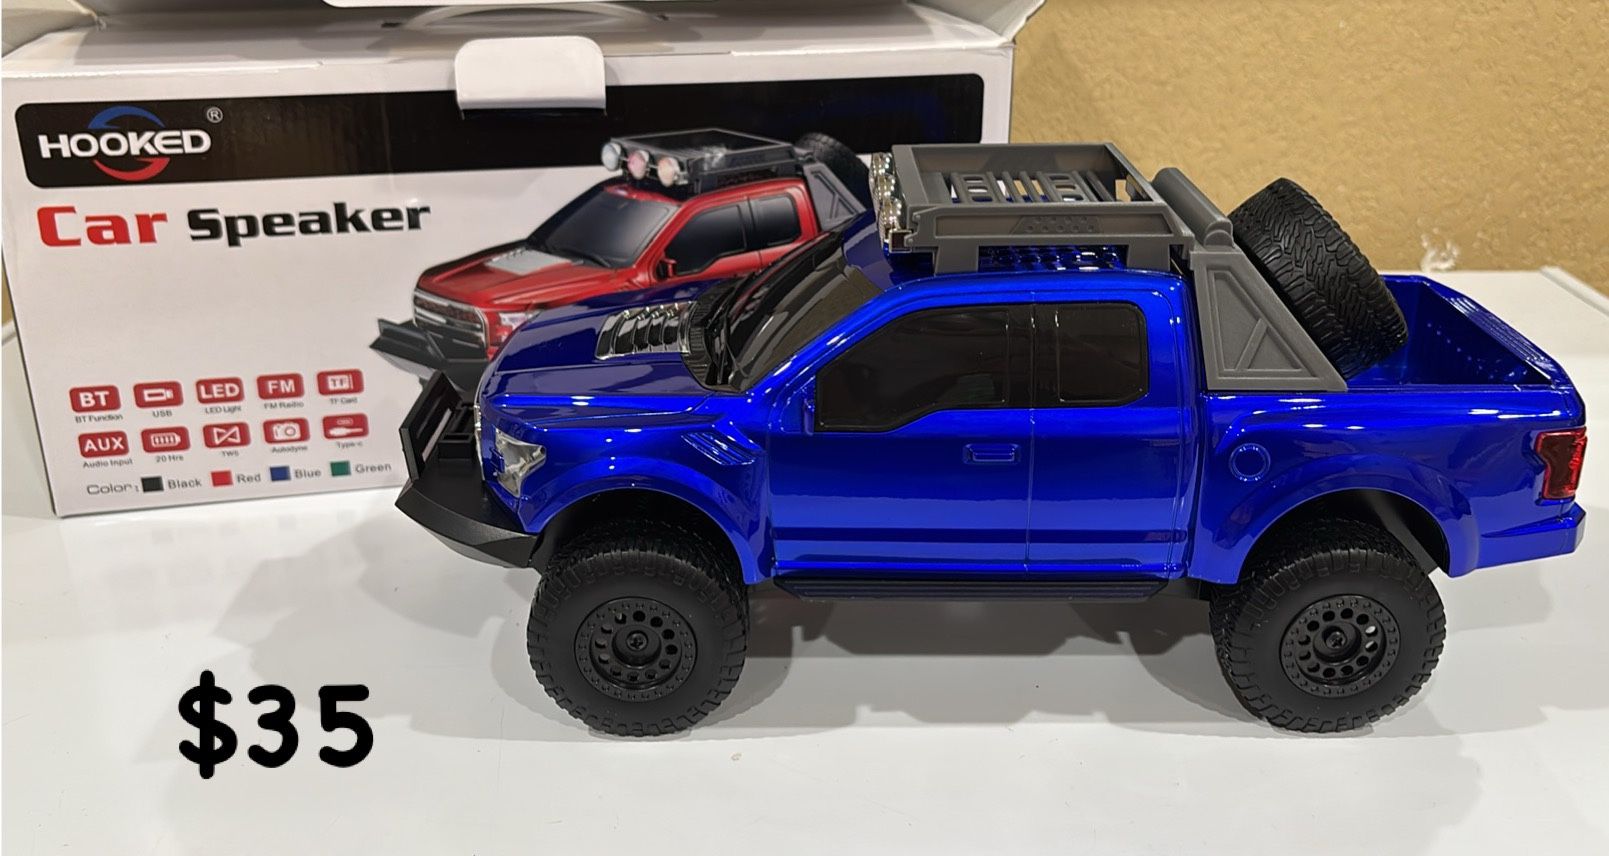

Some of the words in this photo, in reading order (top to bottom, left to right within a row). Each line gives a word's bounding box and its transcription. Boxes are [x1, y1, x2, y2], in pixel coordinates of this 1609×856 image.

[37, 129, 212, 159] HOOKED
[36, 205, 168, 247] Car
[186, 201, 431, 247] Speaker
[199, 383, 240, 400] LED
[267, 378, 296, 395] FM
[78, 390, 110, 408] BT
[152, 410, 173, 418] USB
[205, 406, 222, 415] LED
[223, 405, 242, 415] Light
[75, 415, 88, 424] BT
[84, 437, 125, 453] AUX
[83, 459, 109, 469] Audio
[110, 458, 133, 468] Input
[155, 455, 168, 464] 20
[167, 478, 202, 490] Black
[236, 473, 262, 484] Red
[294, 469, 322, 479] Blue
[354, 463, 392, 474] Green
